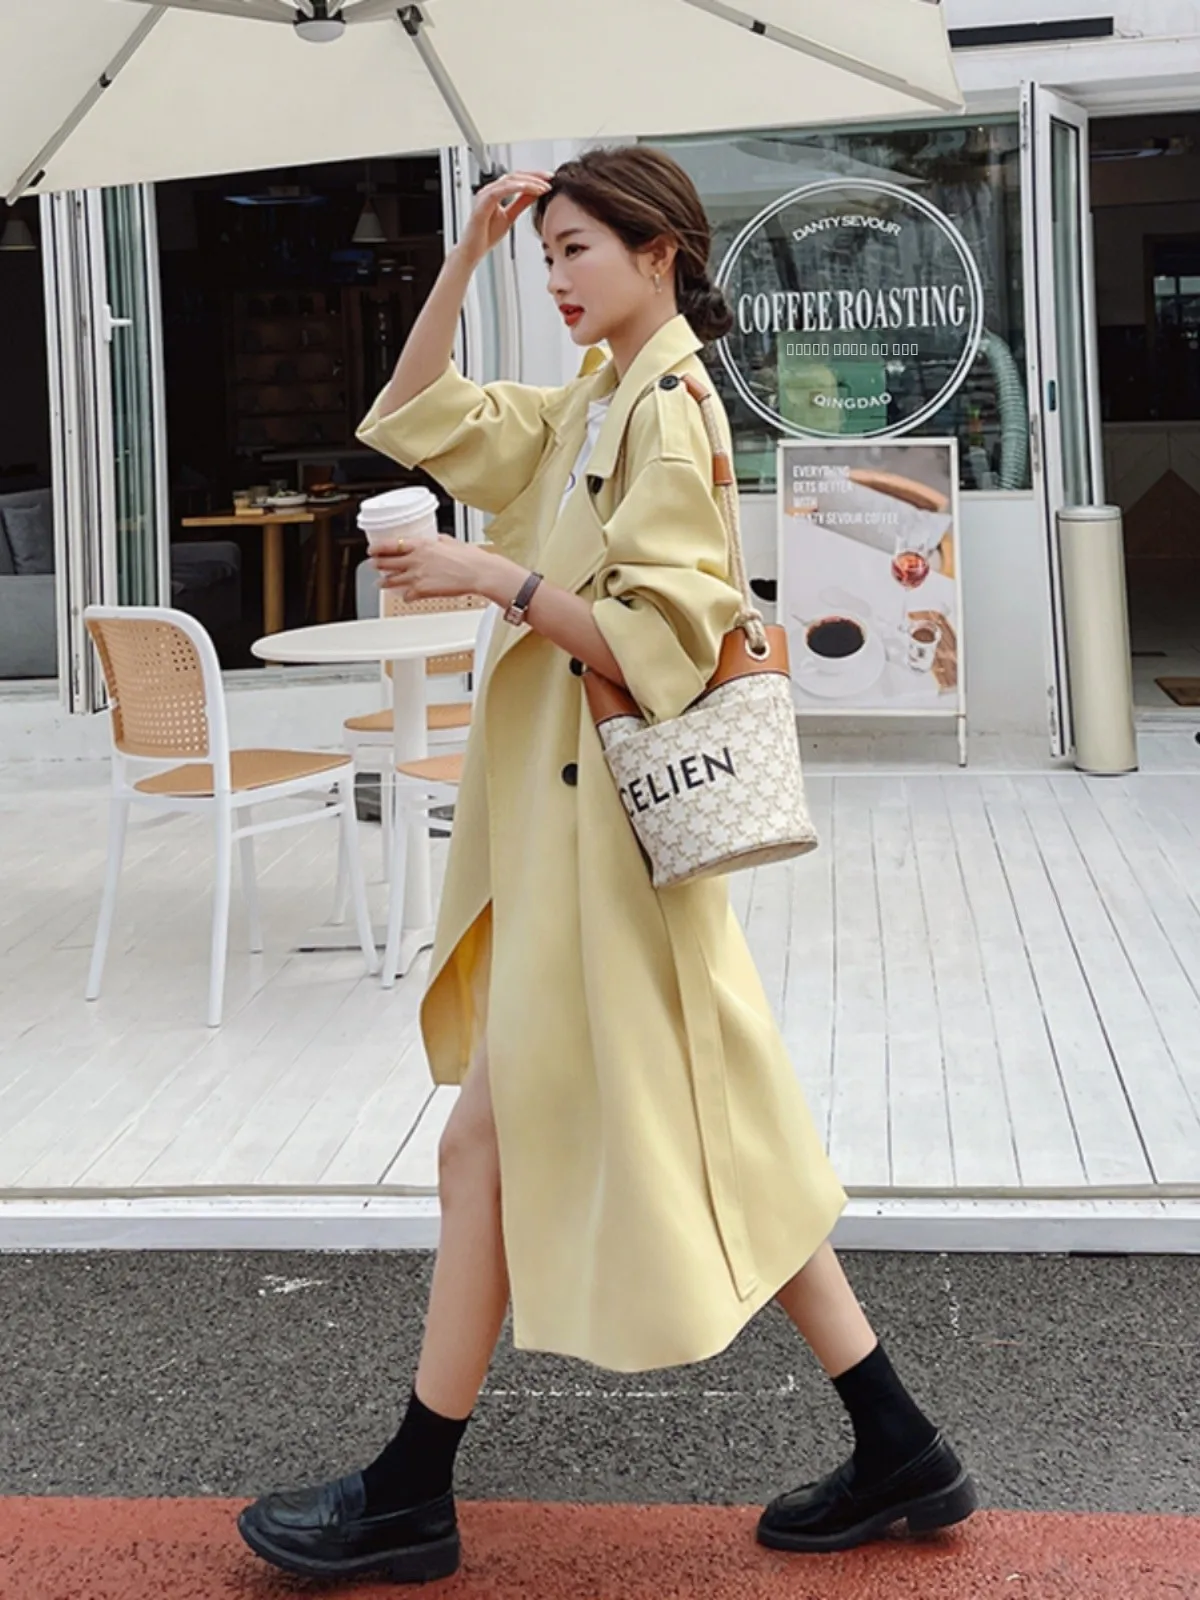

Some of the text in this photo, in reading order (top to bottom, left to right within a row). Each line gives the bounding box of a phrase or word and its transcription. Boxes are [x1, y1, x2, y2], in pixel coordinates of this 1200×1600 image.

[792, 215, 902, 241] DANTY SEVOUR
[738, 284, 966, 334] COFFEE ROASTING
[813, 392, 892, 409] QINGDAO
